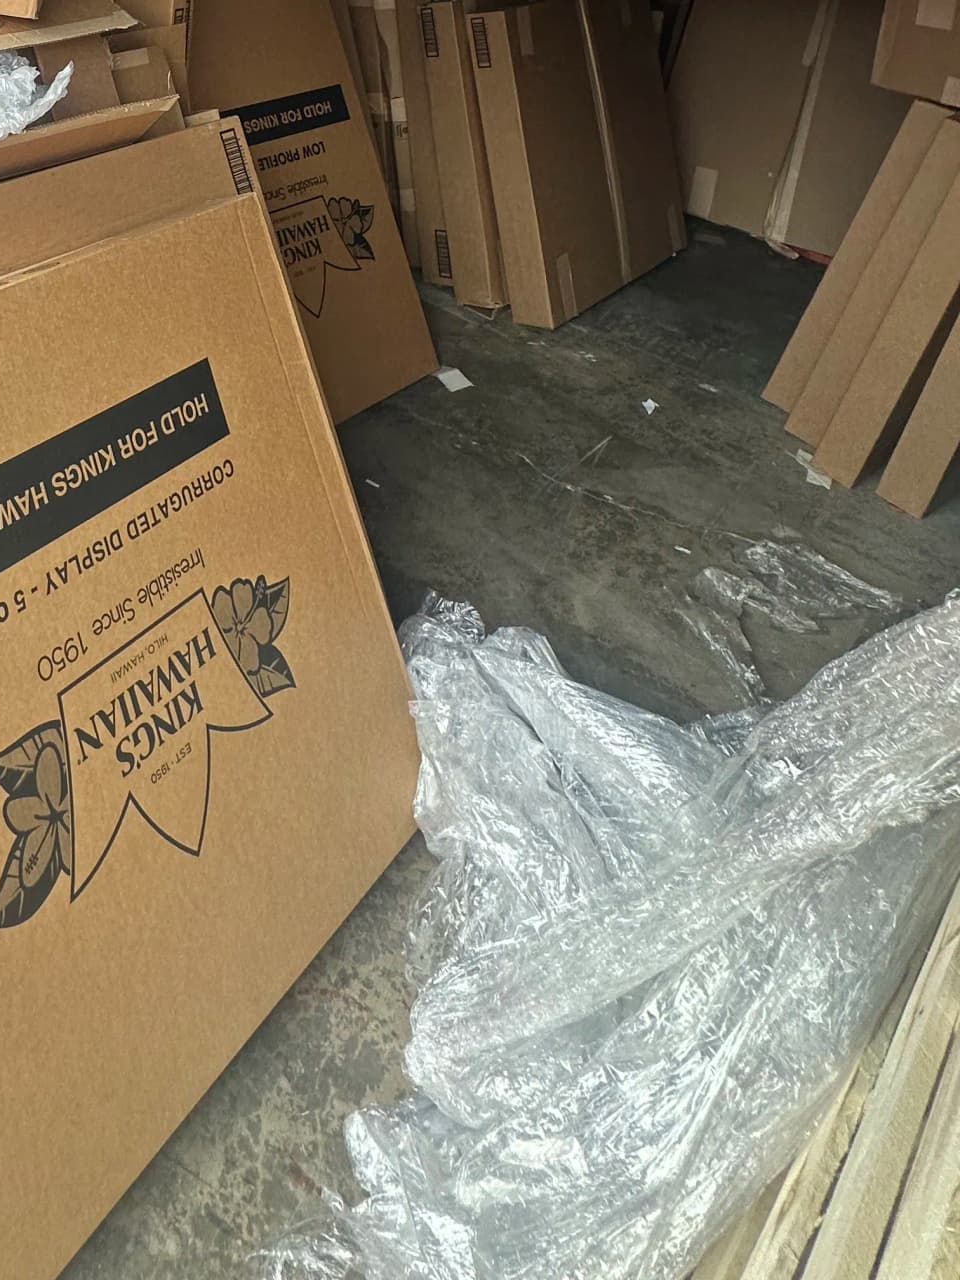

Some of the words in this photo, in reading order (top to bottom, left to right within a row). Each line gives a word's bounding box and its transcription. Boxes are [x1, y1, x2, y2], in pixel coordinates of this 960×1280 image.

[243, 114, 279, 133] KINGS
[280, 108, 301, 124] FOR
[303, 100, 332, 118] HOLD
[257, 148, 299, 171] PROFILE
[302, 141, 326, 159] LOW
[287, 174, 328, 194] Irresistible
[160, 393, 209, 435] HOLD
[117, 421, 159, 459] FOR
[51, 444, 116, 497] KINGS
[126, 459, 234, 540] CORRUGATED
[45, 528, 124, 596] DISPLAY
[136, 548, 205, 606] Irresistible
[13, 590, 26, 613] 5
[91, 598, 136, 636] Since
[37, 631, 89, 682] 1950
[144, 633, 169, 655] HILO,
[110, 651, 145, 683] HAWAII
[73, 627, 217, 762] HAWAIIAN
[115, 680, 204, 778] KING'S
[175, 742, 193, 764] EST
[150, 763, 170, 784] 1950
